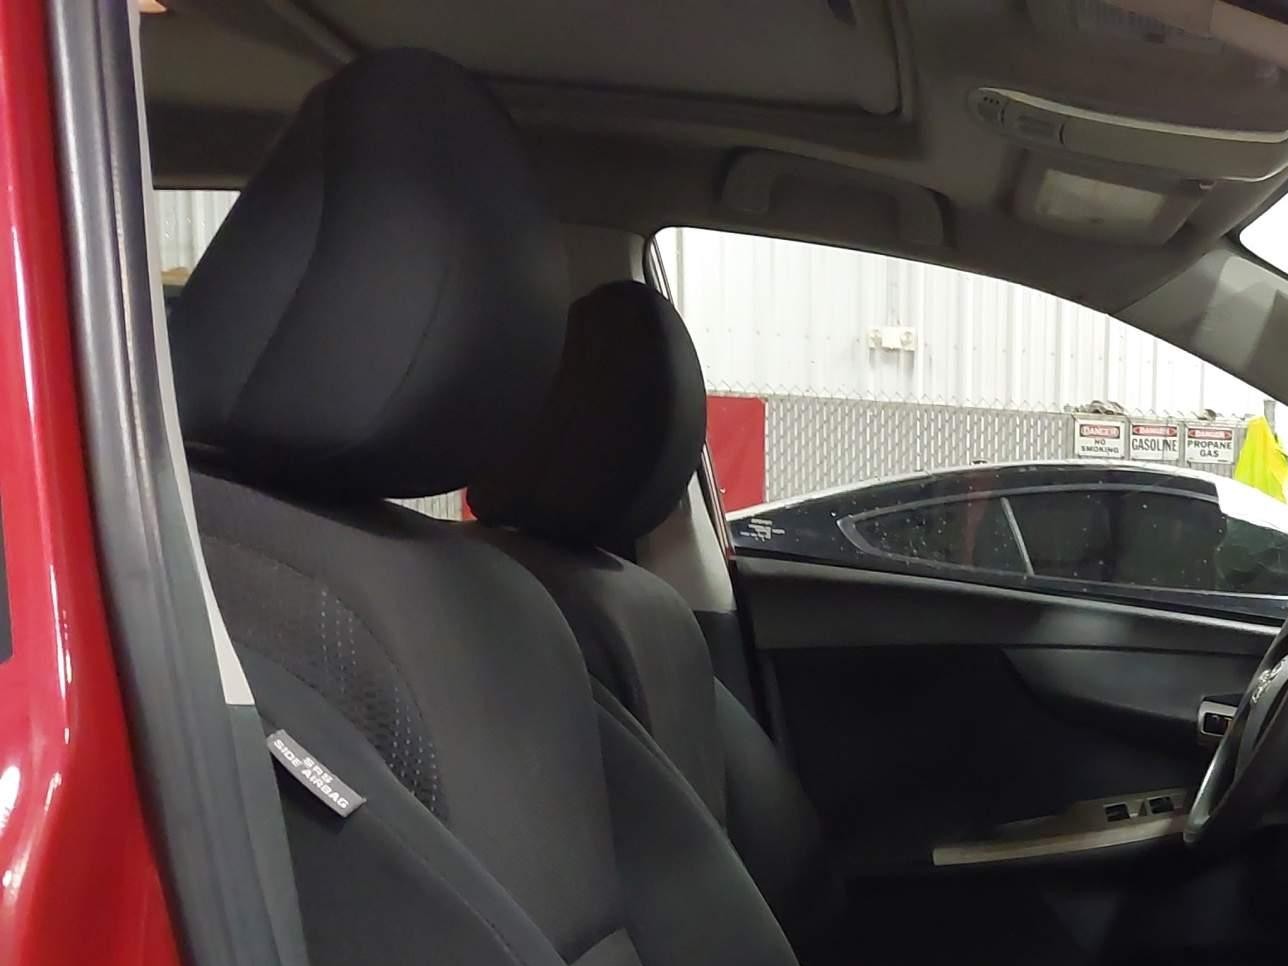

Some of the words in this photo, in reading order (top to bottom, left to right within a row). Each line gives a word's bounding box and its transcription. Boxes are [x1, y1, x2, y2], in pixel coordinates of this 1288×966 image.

[1081, 446, 1119, 454] SMOKING
[1132, 439, 1177, 452] GASOLINE
[1187, 440, 1232, 450] PROPANE
[1200, 449, 1220, 458] GAS
[274, 739, 302, 767] SIDE
[301, 769, 350, 809] AIRBAG
[303, 757, 333, 783] SRS
